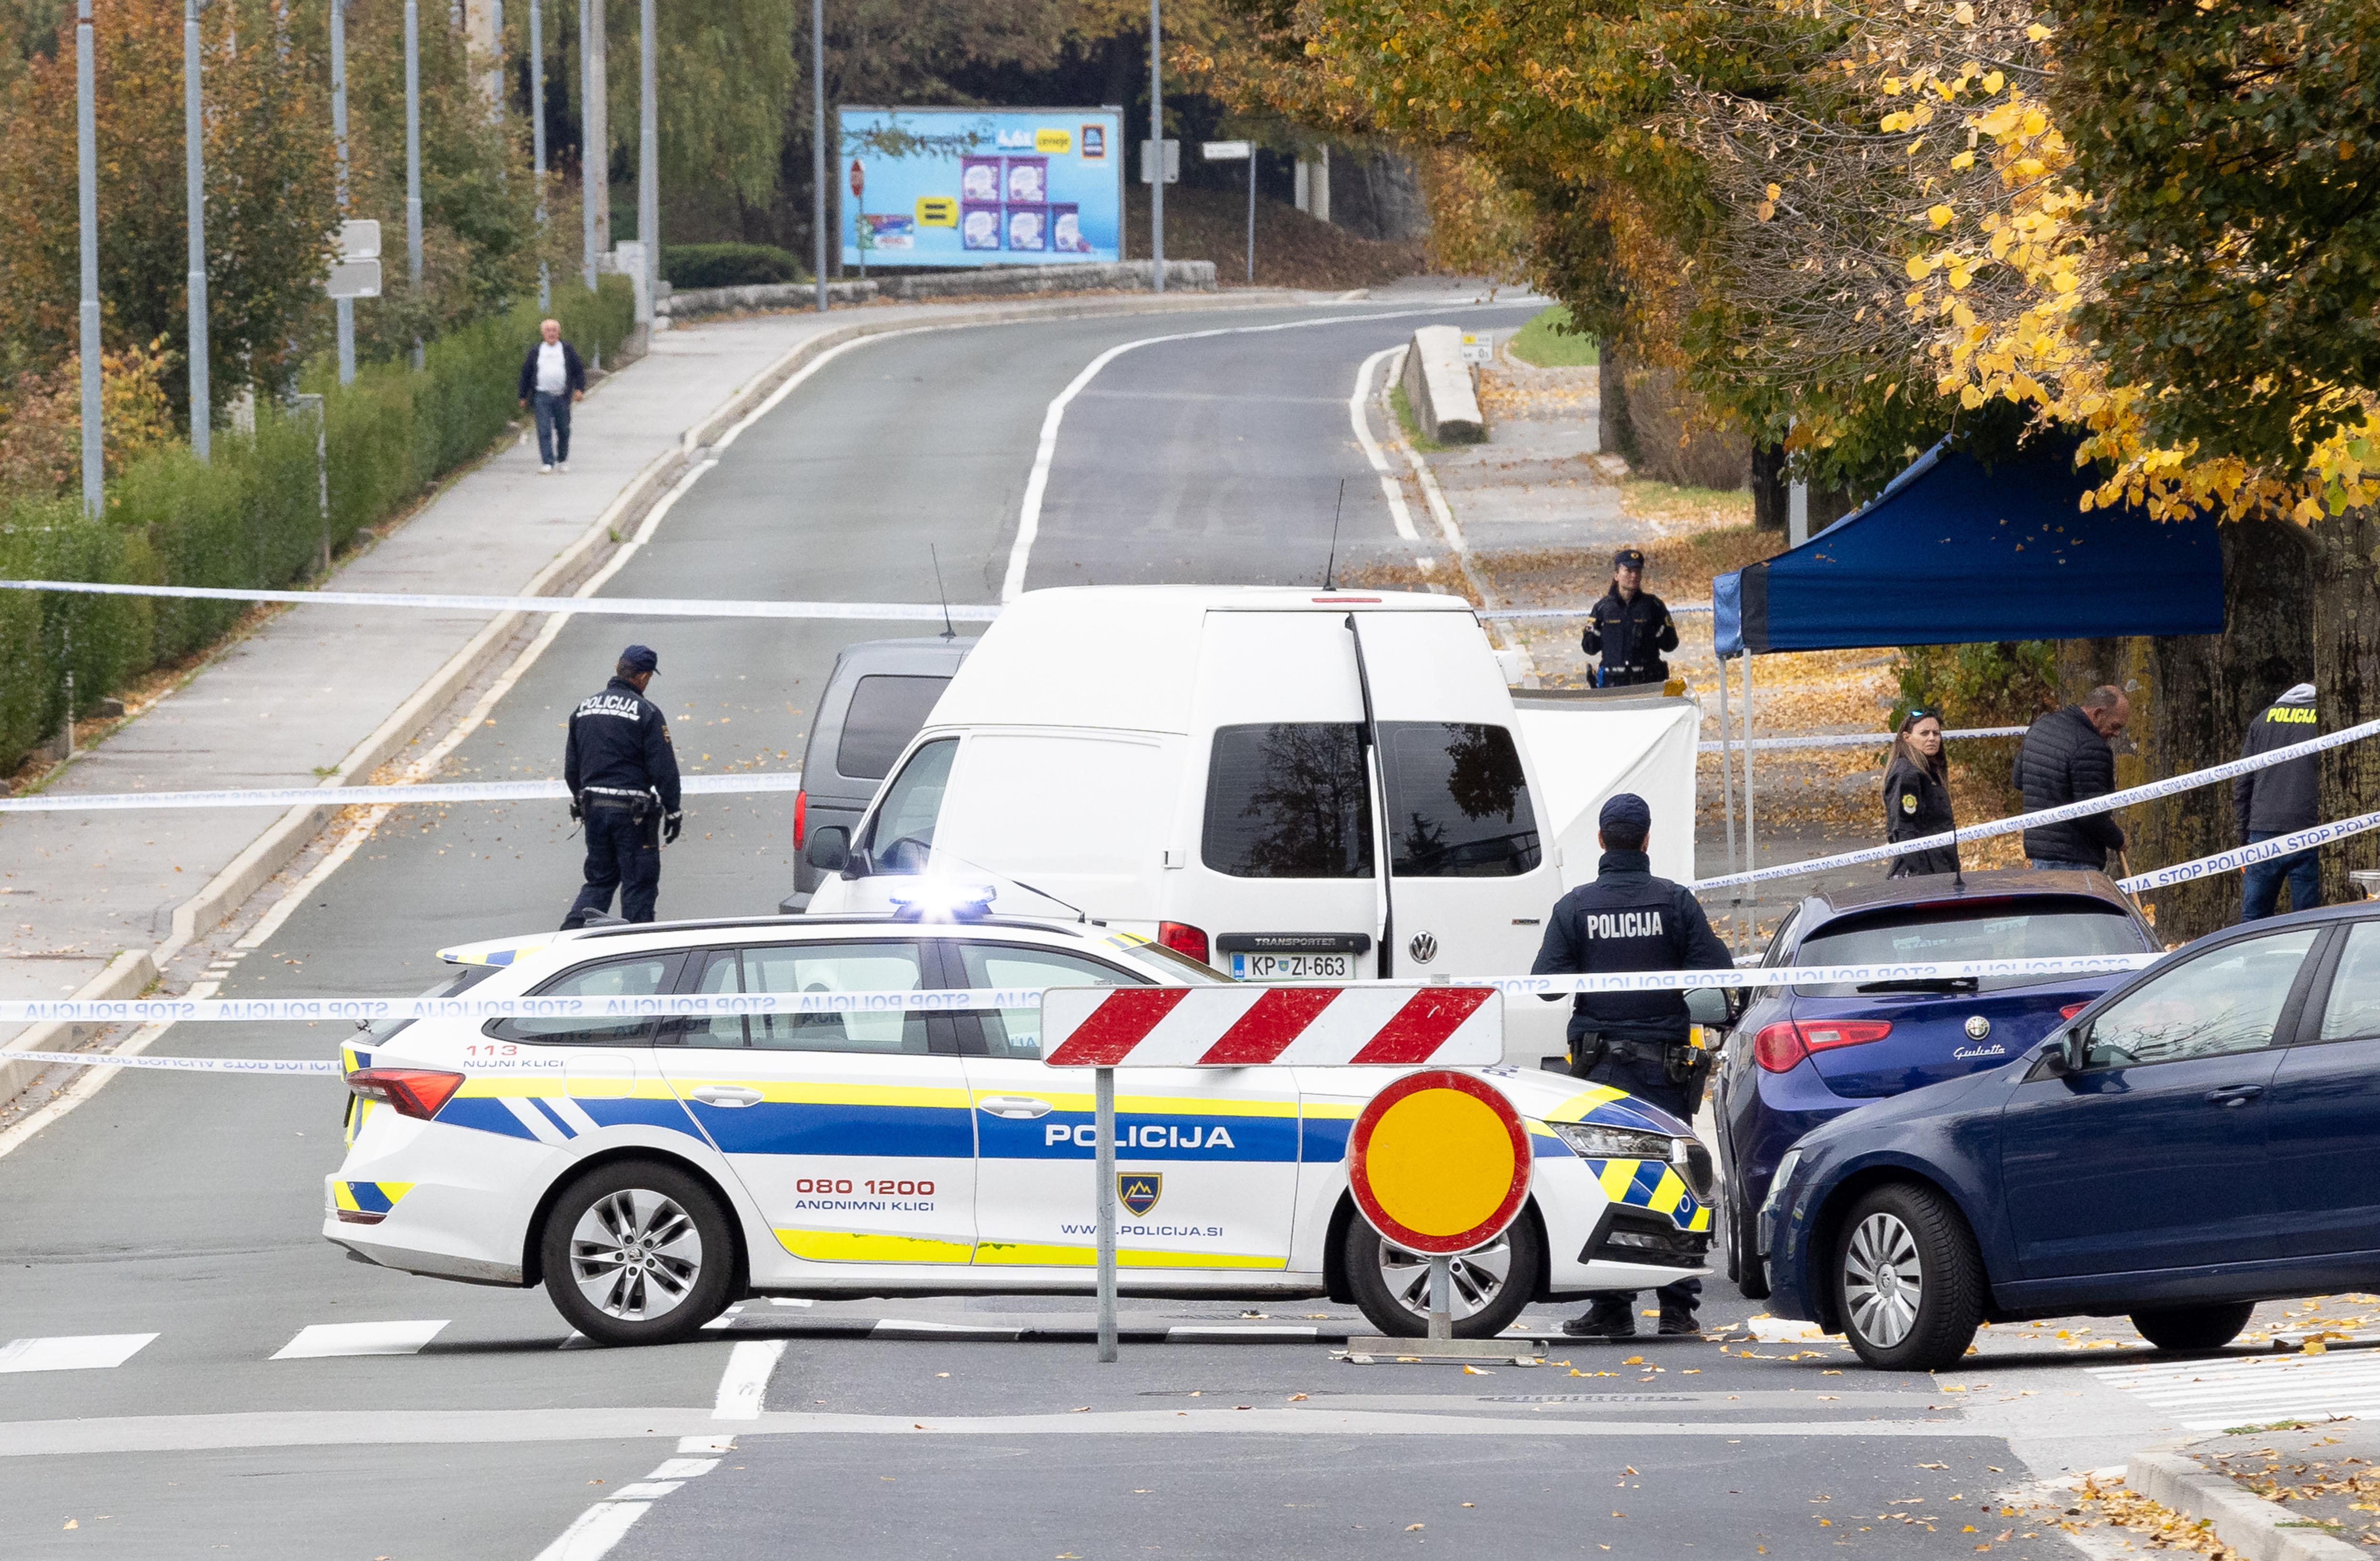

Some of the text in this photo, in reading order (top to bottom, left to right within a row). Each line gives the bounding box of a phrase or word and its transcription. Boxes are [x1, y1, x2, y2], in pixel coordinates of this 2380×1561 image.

[579, 695, 639, 715] POLICIJA
[2162, 780, 2181, 792] STOP
[2214, 766, 2233, 778] STOP
[2267, 751, 2285, 763] STOP
[2321, 736, 2339, 748] STOP
[2159, 864, 2202, 884] STOP
[2207, 843, 2281, 873] POLICIJA
[2287, 829, 2330, 850] STOP
[2335, 815, 2380, 836] POLIC
[1587, 912, 1663, 939] POLICIJA
[1254, 938, 1336, 946] TRANSPORTER
[1252, 956, 1276, 976] KP
[1291, 956, 1345, 976] ZI-663
[467, 1045, 517, 1056] 113
[1954, 1044, 2005, 1060] Giulietta
[796, 1179, 935, 1195] 080 1200
[795, 1200, 934, 1211] ANONIMNI KLICI
[1061, 1225, 1223, 1236] WW.POLICIJA.SI
